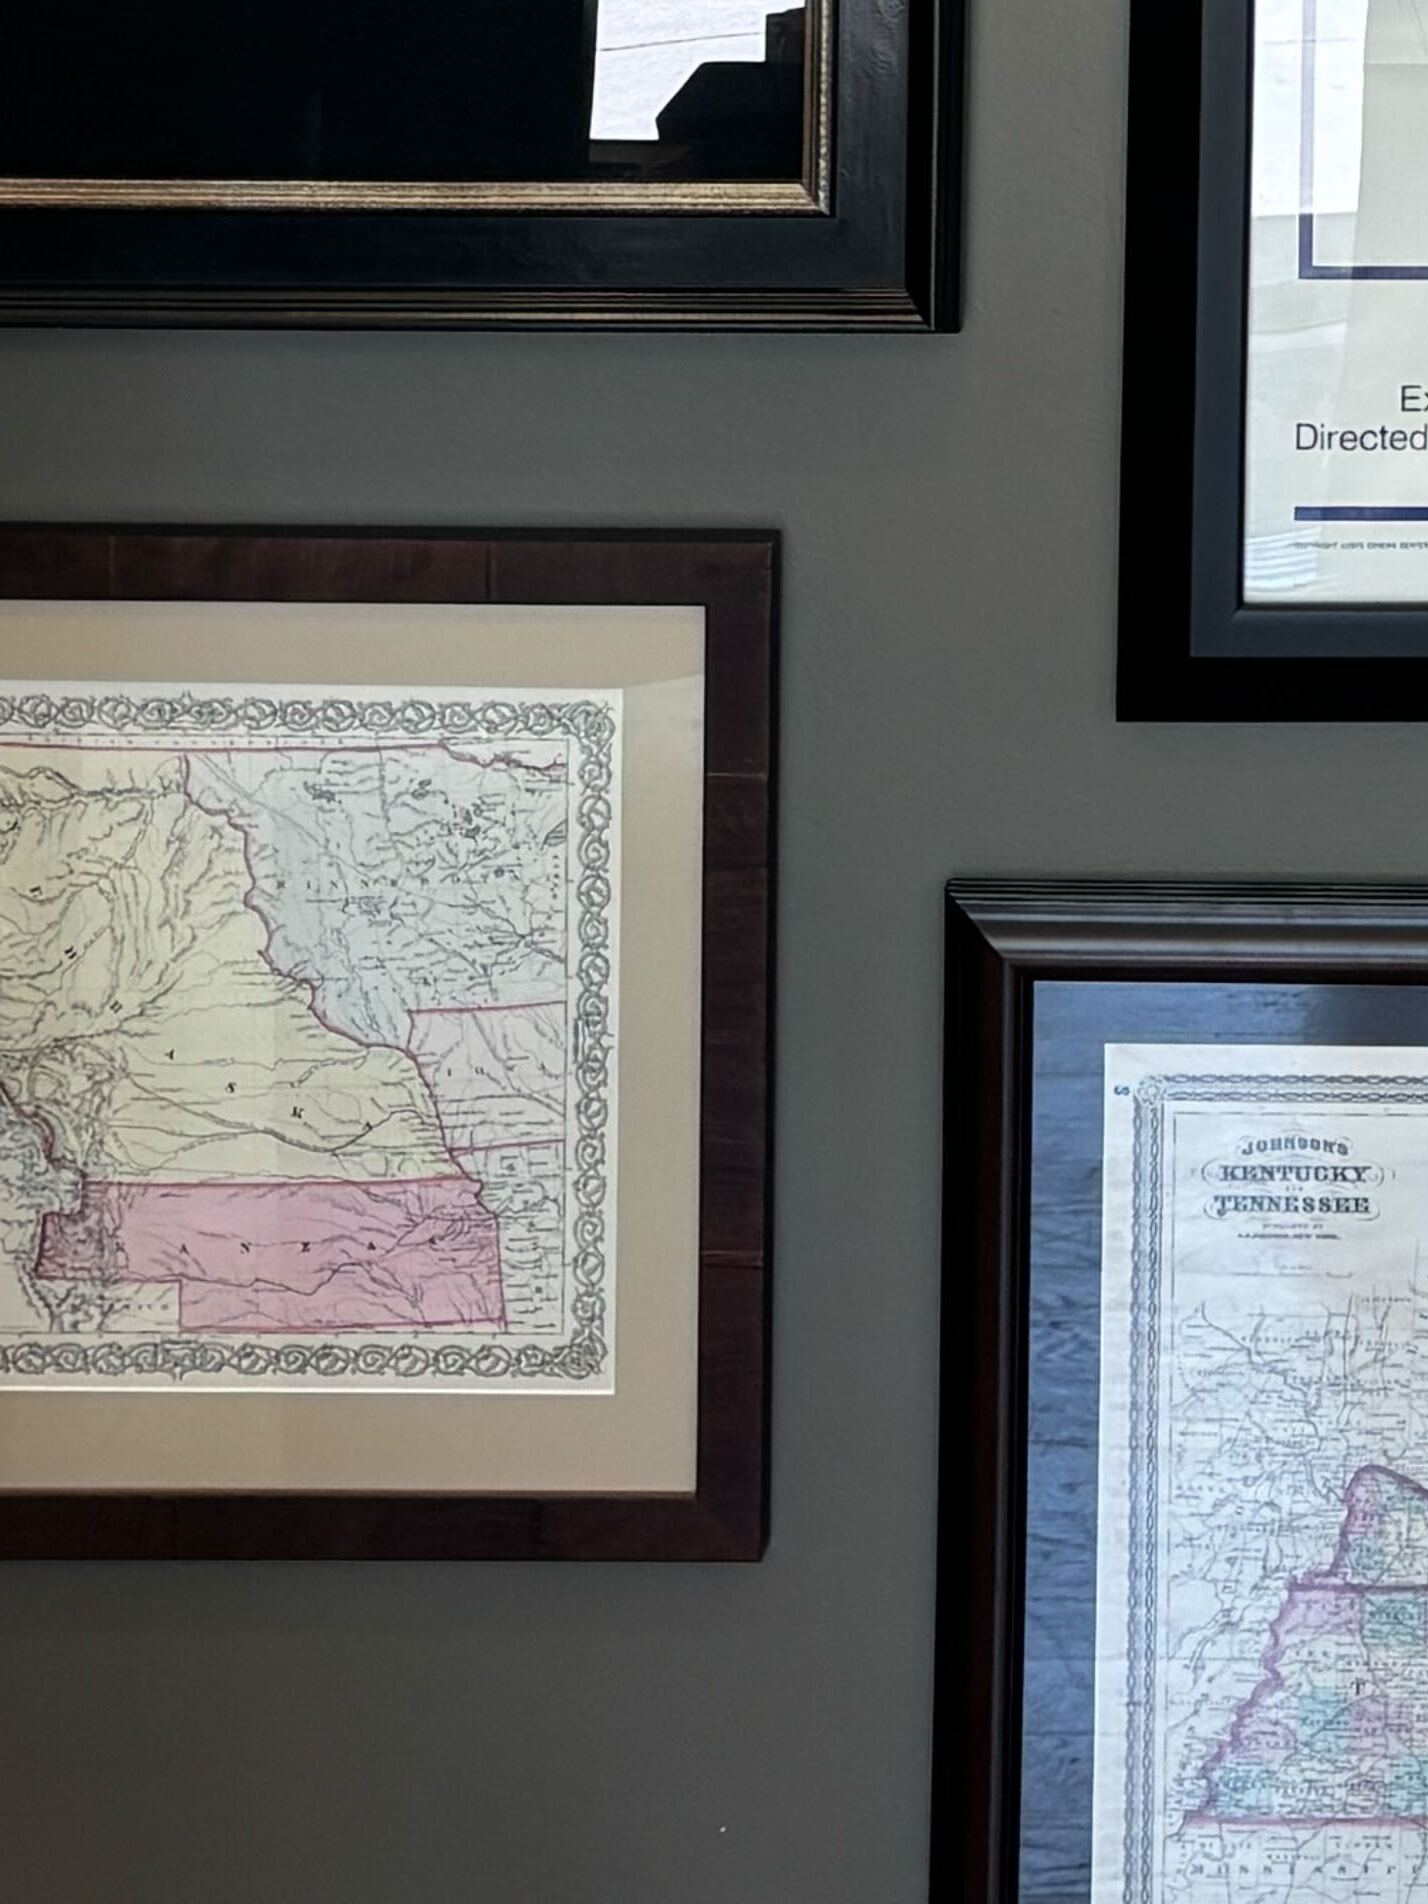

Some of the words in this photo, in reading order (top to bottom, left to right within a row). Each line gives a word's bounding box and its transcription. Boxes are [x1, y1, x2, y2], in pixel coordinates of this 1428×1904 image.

[1294, 422, 1428, 454] Directed
[1219, 1165, 1371, 1182] KENTUCKY
[1214, 1195, 1370, 1216] TENNESSEE
